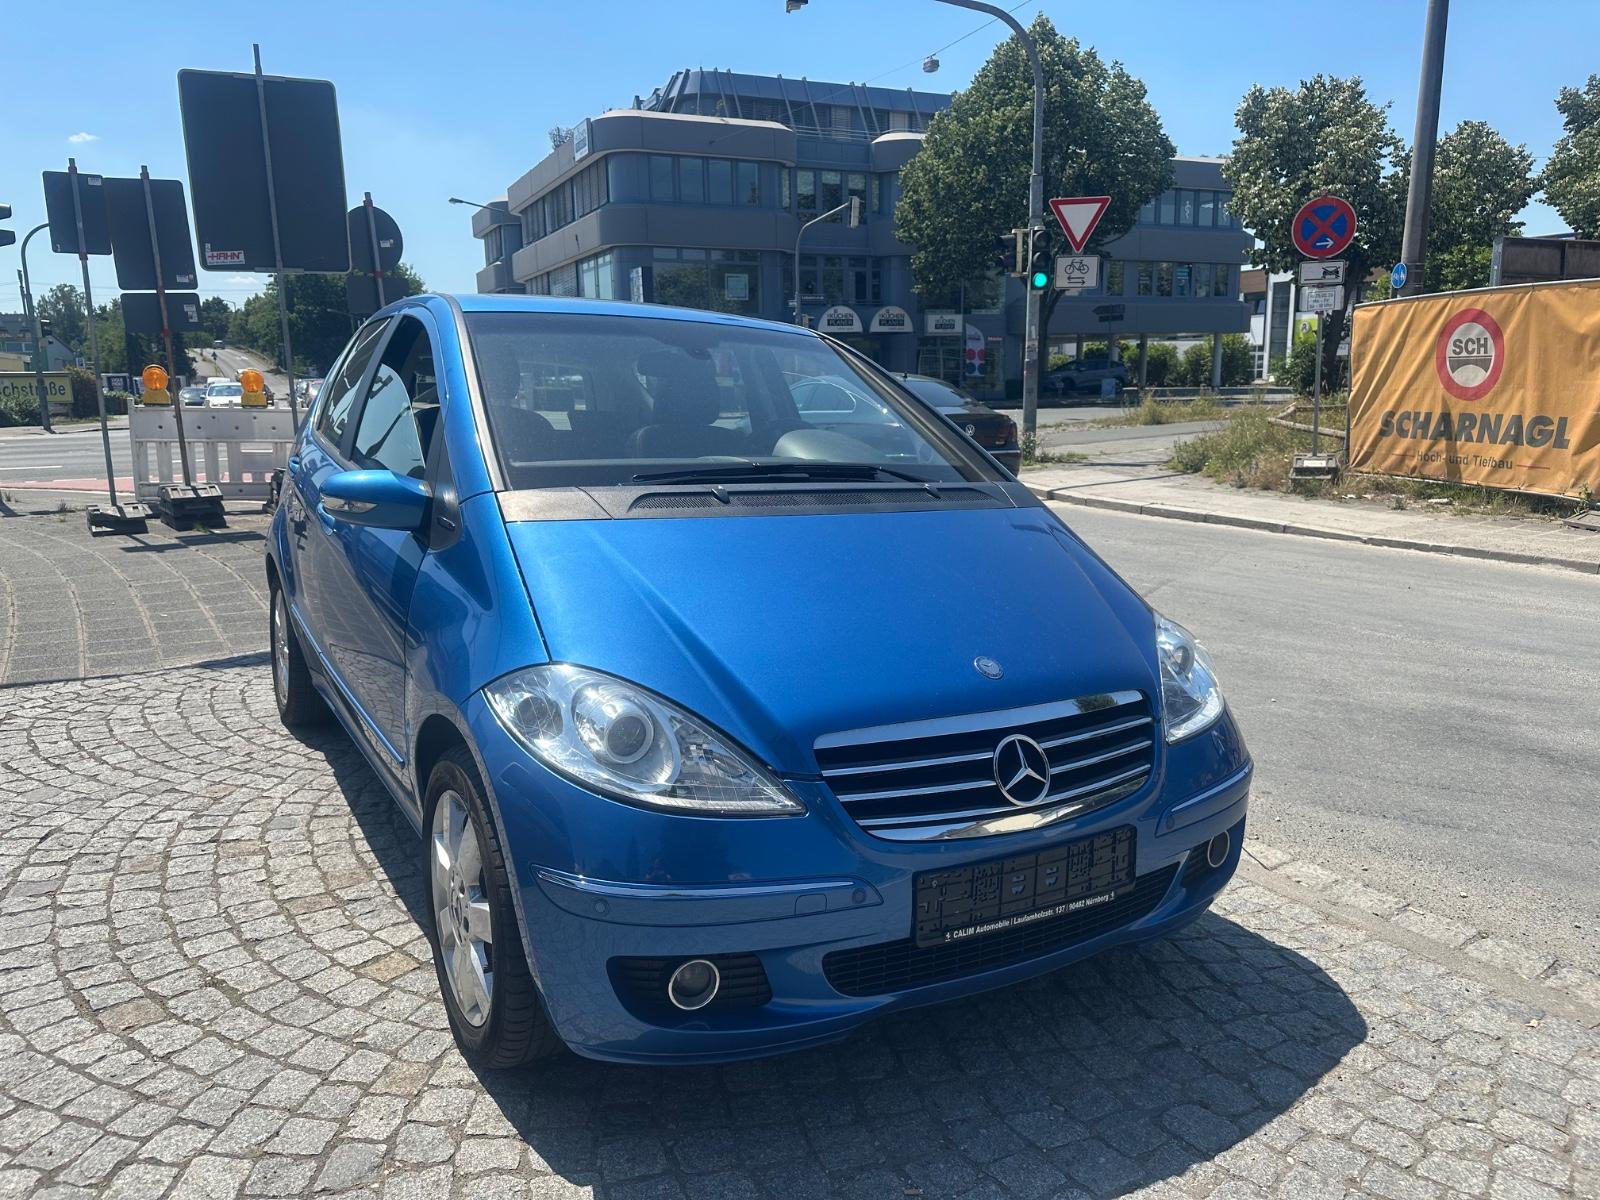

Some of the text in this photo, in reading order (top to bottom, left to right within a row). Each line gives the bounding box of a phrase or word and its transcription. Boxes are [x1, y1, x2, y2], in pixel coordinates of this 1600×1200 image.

[208, 252, 242, 260] HAHN
[1452, 337, 1488, 355] SCH
[1379, 410, 1571, 449] SCHARNAGL
[1417, 450, 1513, 470] Hoch- und Tiefbau
[953, 927, 974, 939] CALIM
[976, 918, 1010, 934] Automobile
[1055, 904, 1066, 913] 137
